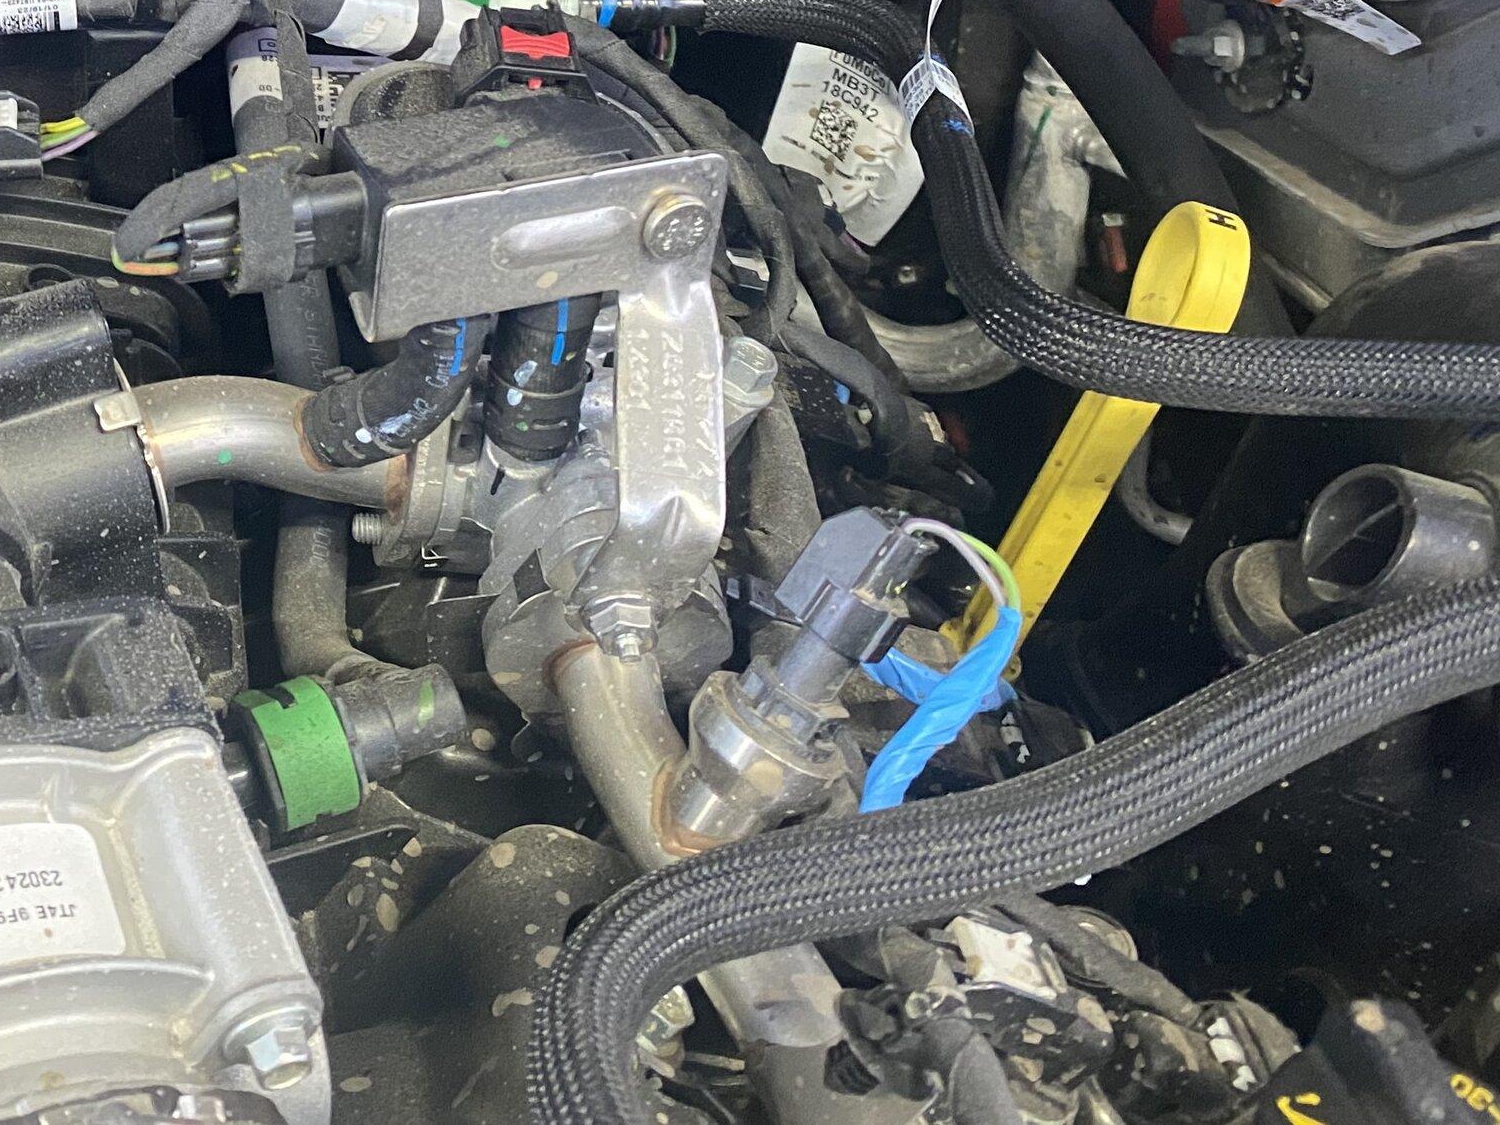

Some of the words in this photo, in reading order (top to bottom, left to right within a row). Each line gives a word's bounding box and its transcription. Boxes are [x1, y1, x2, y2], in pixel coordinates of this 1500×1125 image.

[822, 81, 879, 123] 18C942
[832, 68, 880, 102] MB3T
[36, 903, 77, 920] JT4E
